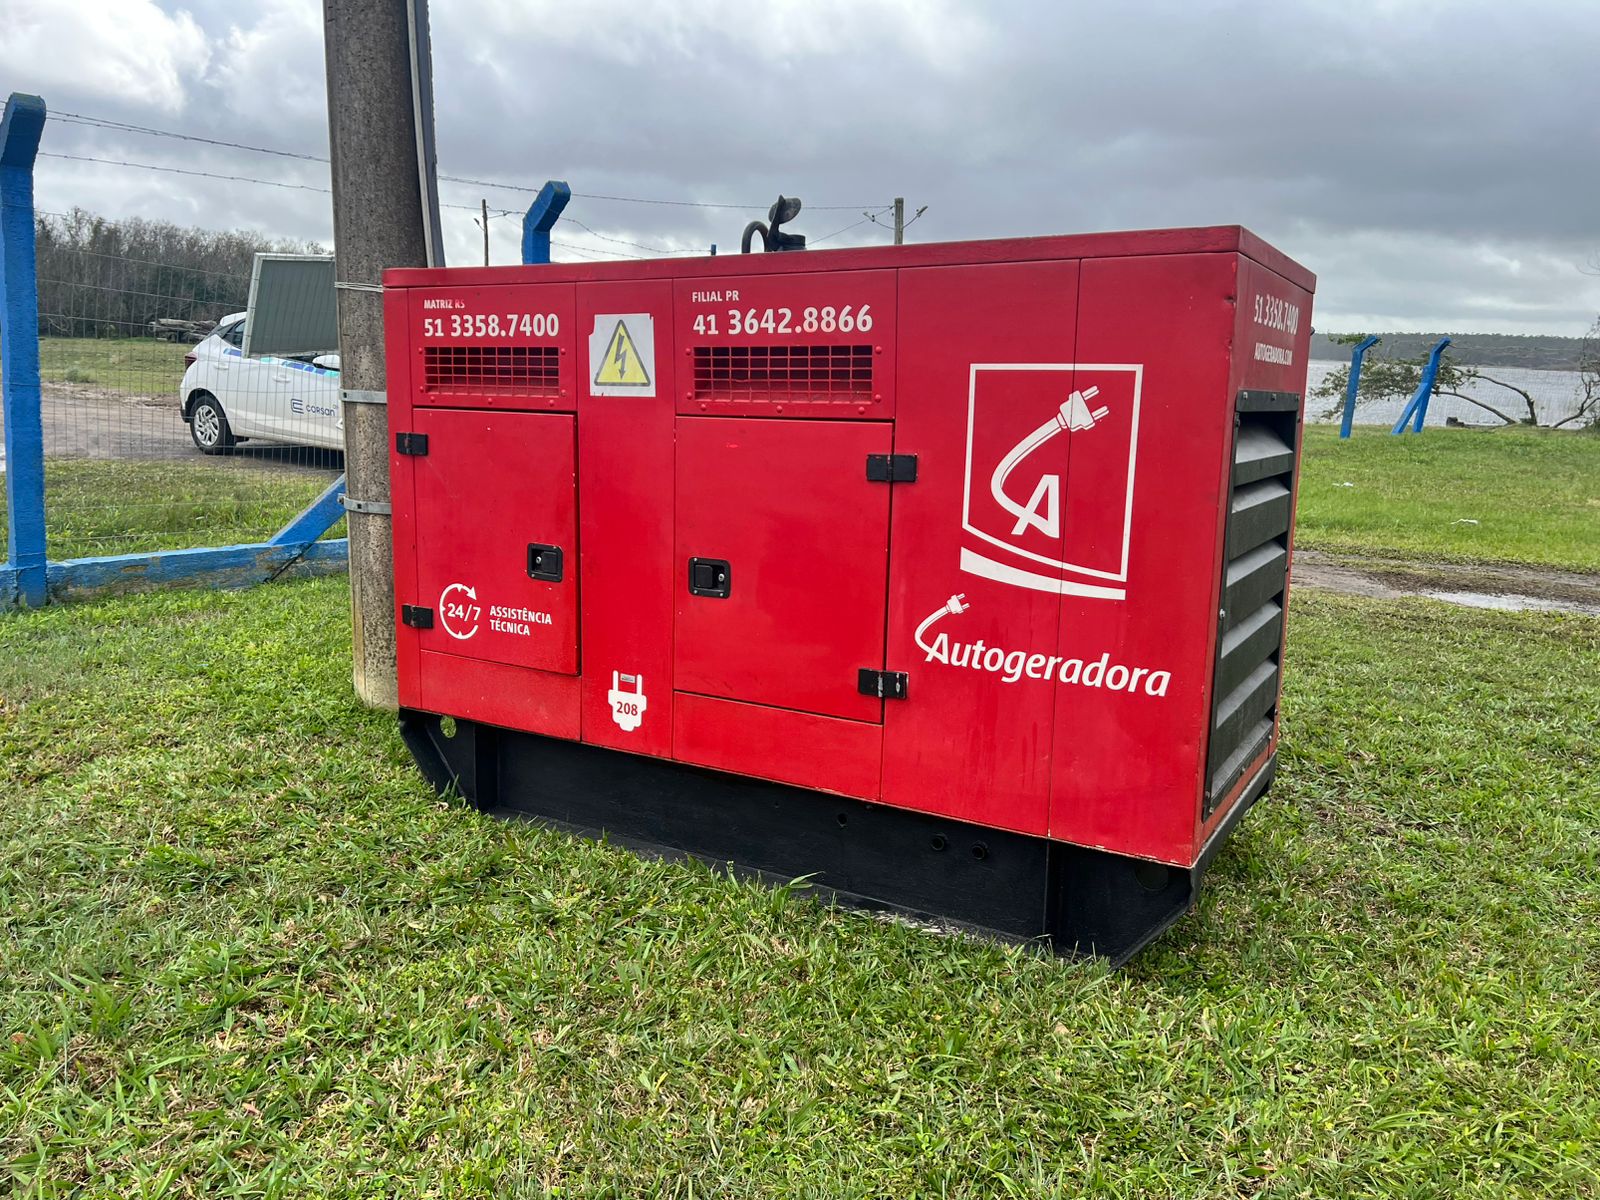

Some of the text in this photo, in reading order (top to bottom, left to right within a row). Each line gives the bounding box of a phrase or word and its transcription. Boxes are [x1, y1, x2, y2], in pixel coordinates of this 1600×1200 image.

[423, 299, 453, 309] MATRIZ
[692, 289, 740, 303] FILIAL PR
[1254, 294, 1264, 324] 51
[423, 312, 560, 338] 51 3358.7400
[692, 303, 873, 336] 41 3642.8866
[446, 602, 482, 622] 24/7
[489, 605, 553, 625] ASSISTÊNCIA
[489, 618, 531, 636] TÉCNICA
[924, 632, 1172, 698] Autogeradora
[616, 700, 639, 717] 208
